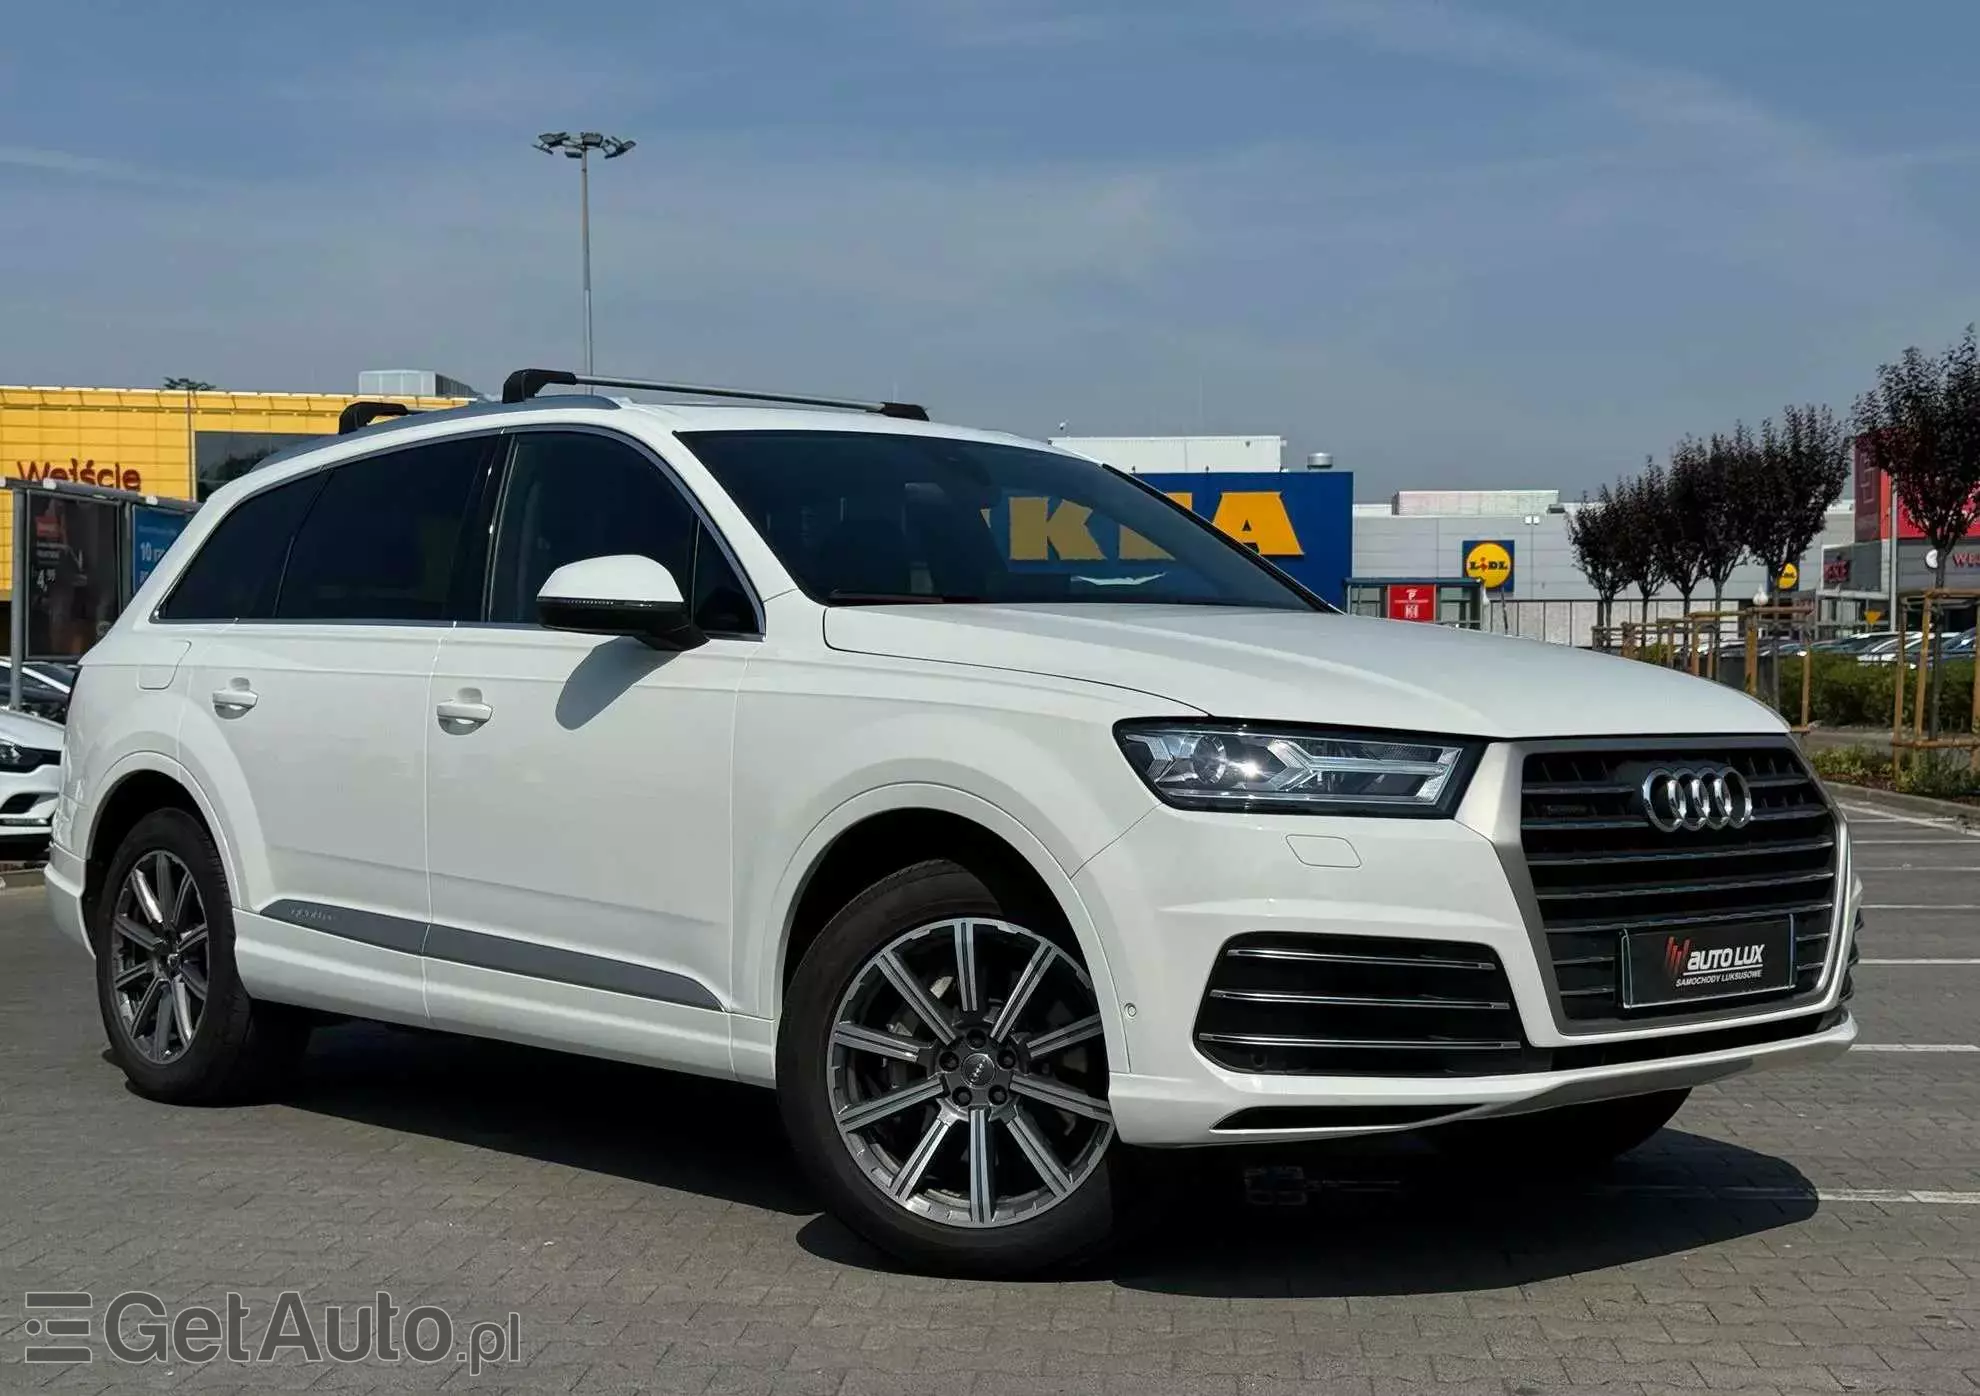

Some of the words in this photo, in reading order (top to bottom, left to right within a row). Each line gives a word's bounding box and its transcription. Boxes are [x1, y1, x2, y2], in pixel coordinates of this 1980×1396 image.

[981, 491, 1304, 561] KA
[1734, 943, 1766, 966] LUX
[1675, 973, 1722, 988] SAMOCHODY
[1721, 968, 1763, 983] LUKSUSOWE
